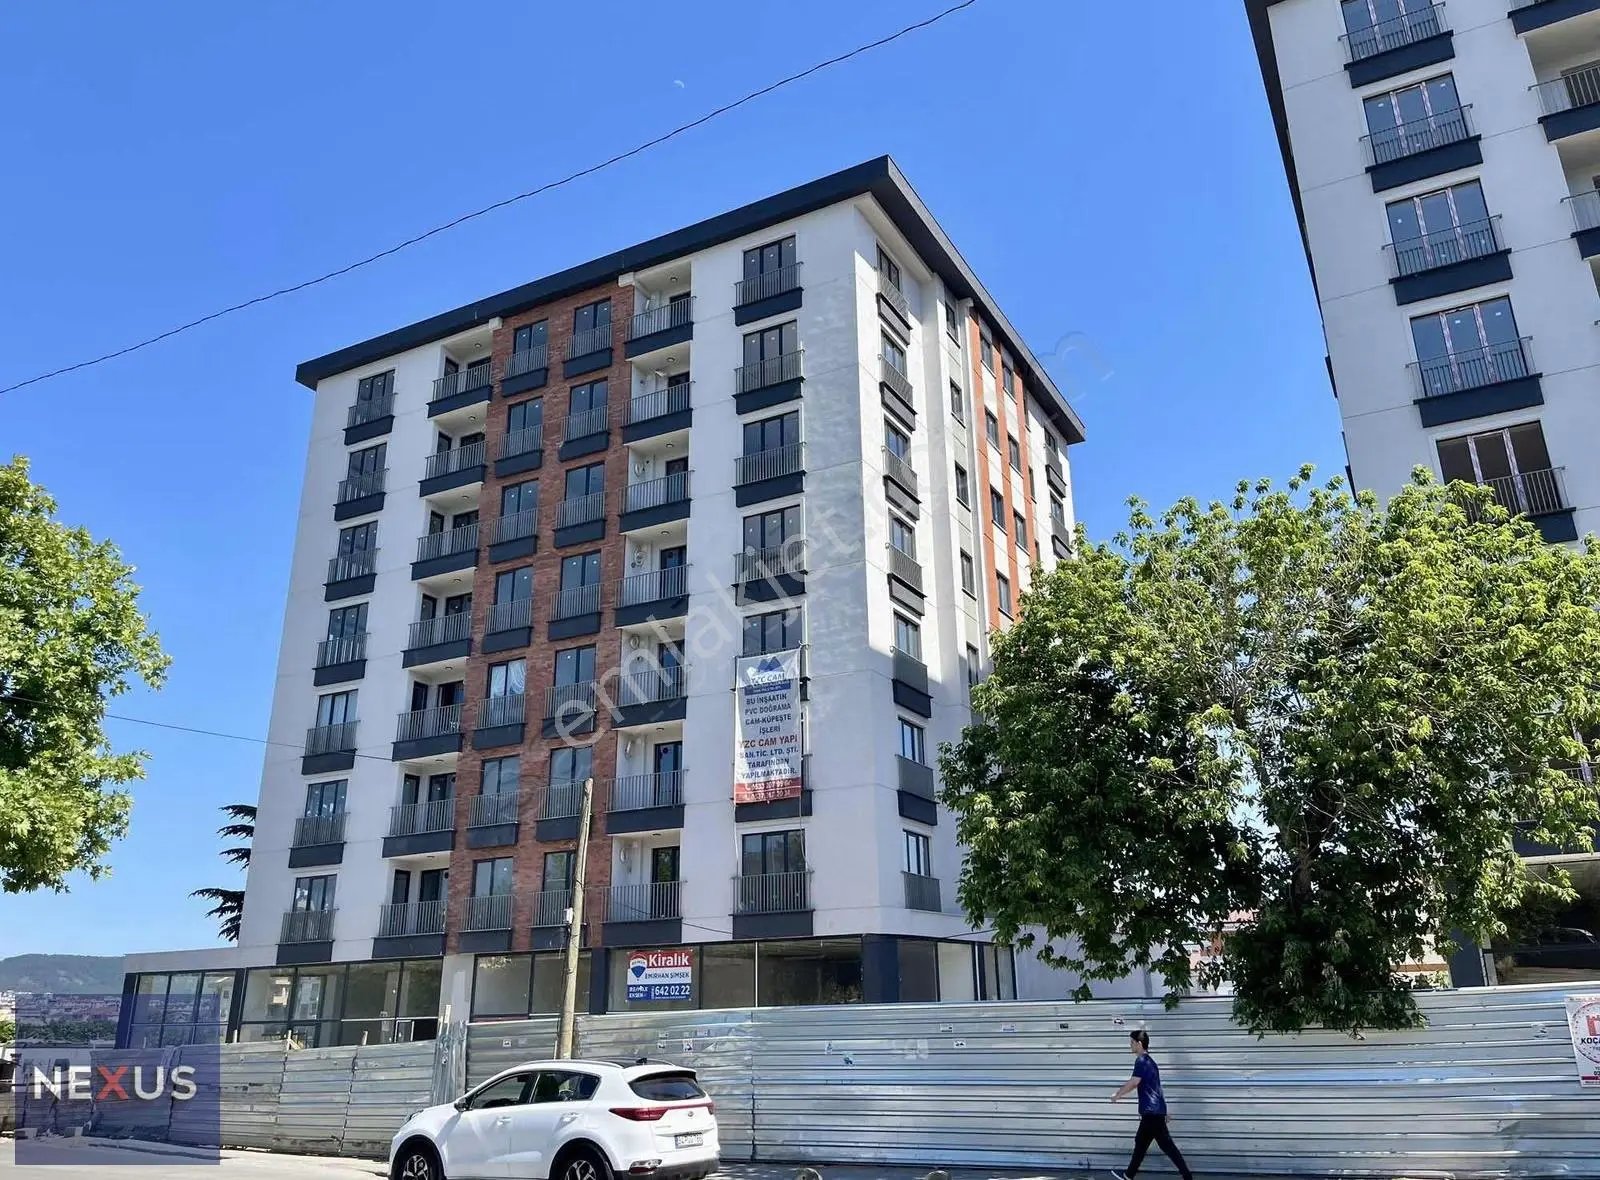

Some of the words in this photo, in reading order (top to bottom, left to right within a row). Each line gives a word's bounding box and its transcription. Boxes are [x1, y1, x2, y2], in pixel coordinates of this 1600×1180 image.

[746, 697, 756, 705] BU
[756, 693, 787, 705] İNŞAATIN
[745, 708, 758, 716] PVC
[760, 703, 791, 714] DOĞRAMA
[745, 713, 791, 726] CAM-KÜPEŞTE
[759, 725, 780, 735] İŞLERİ
[758, 737, 777, 747] CAM
[779, 734, 798, 744] YAPI
[770, 748, 785, 756] LTD.
[649, 952, 689, 967] Kiralık
[655, 986, 669, 996] 642
[670, 985, 680, 995] 02
[681, 985, 690, 995] 22
[1580, 1037, 1600, 1045] KOC
